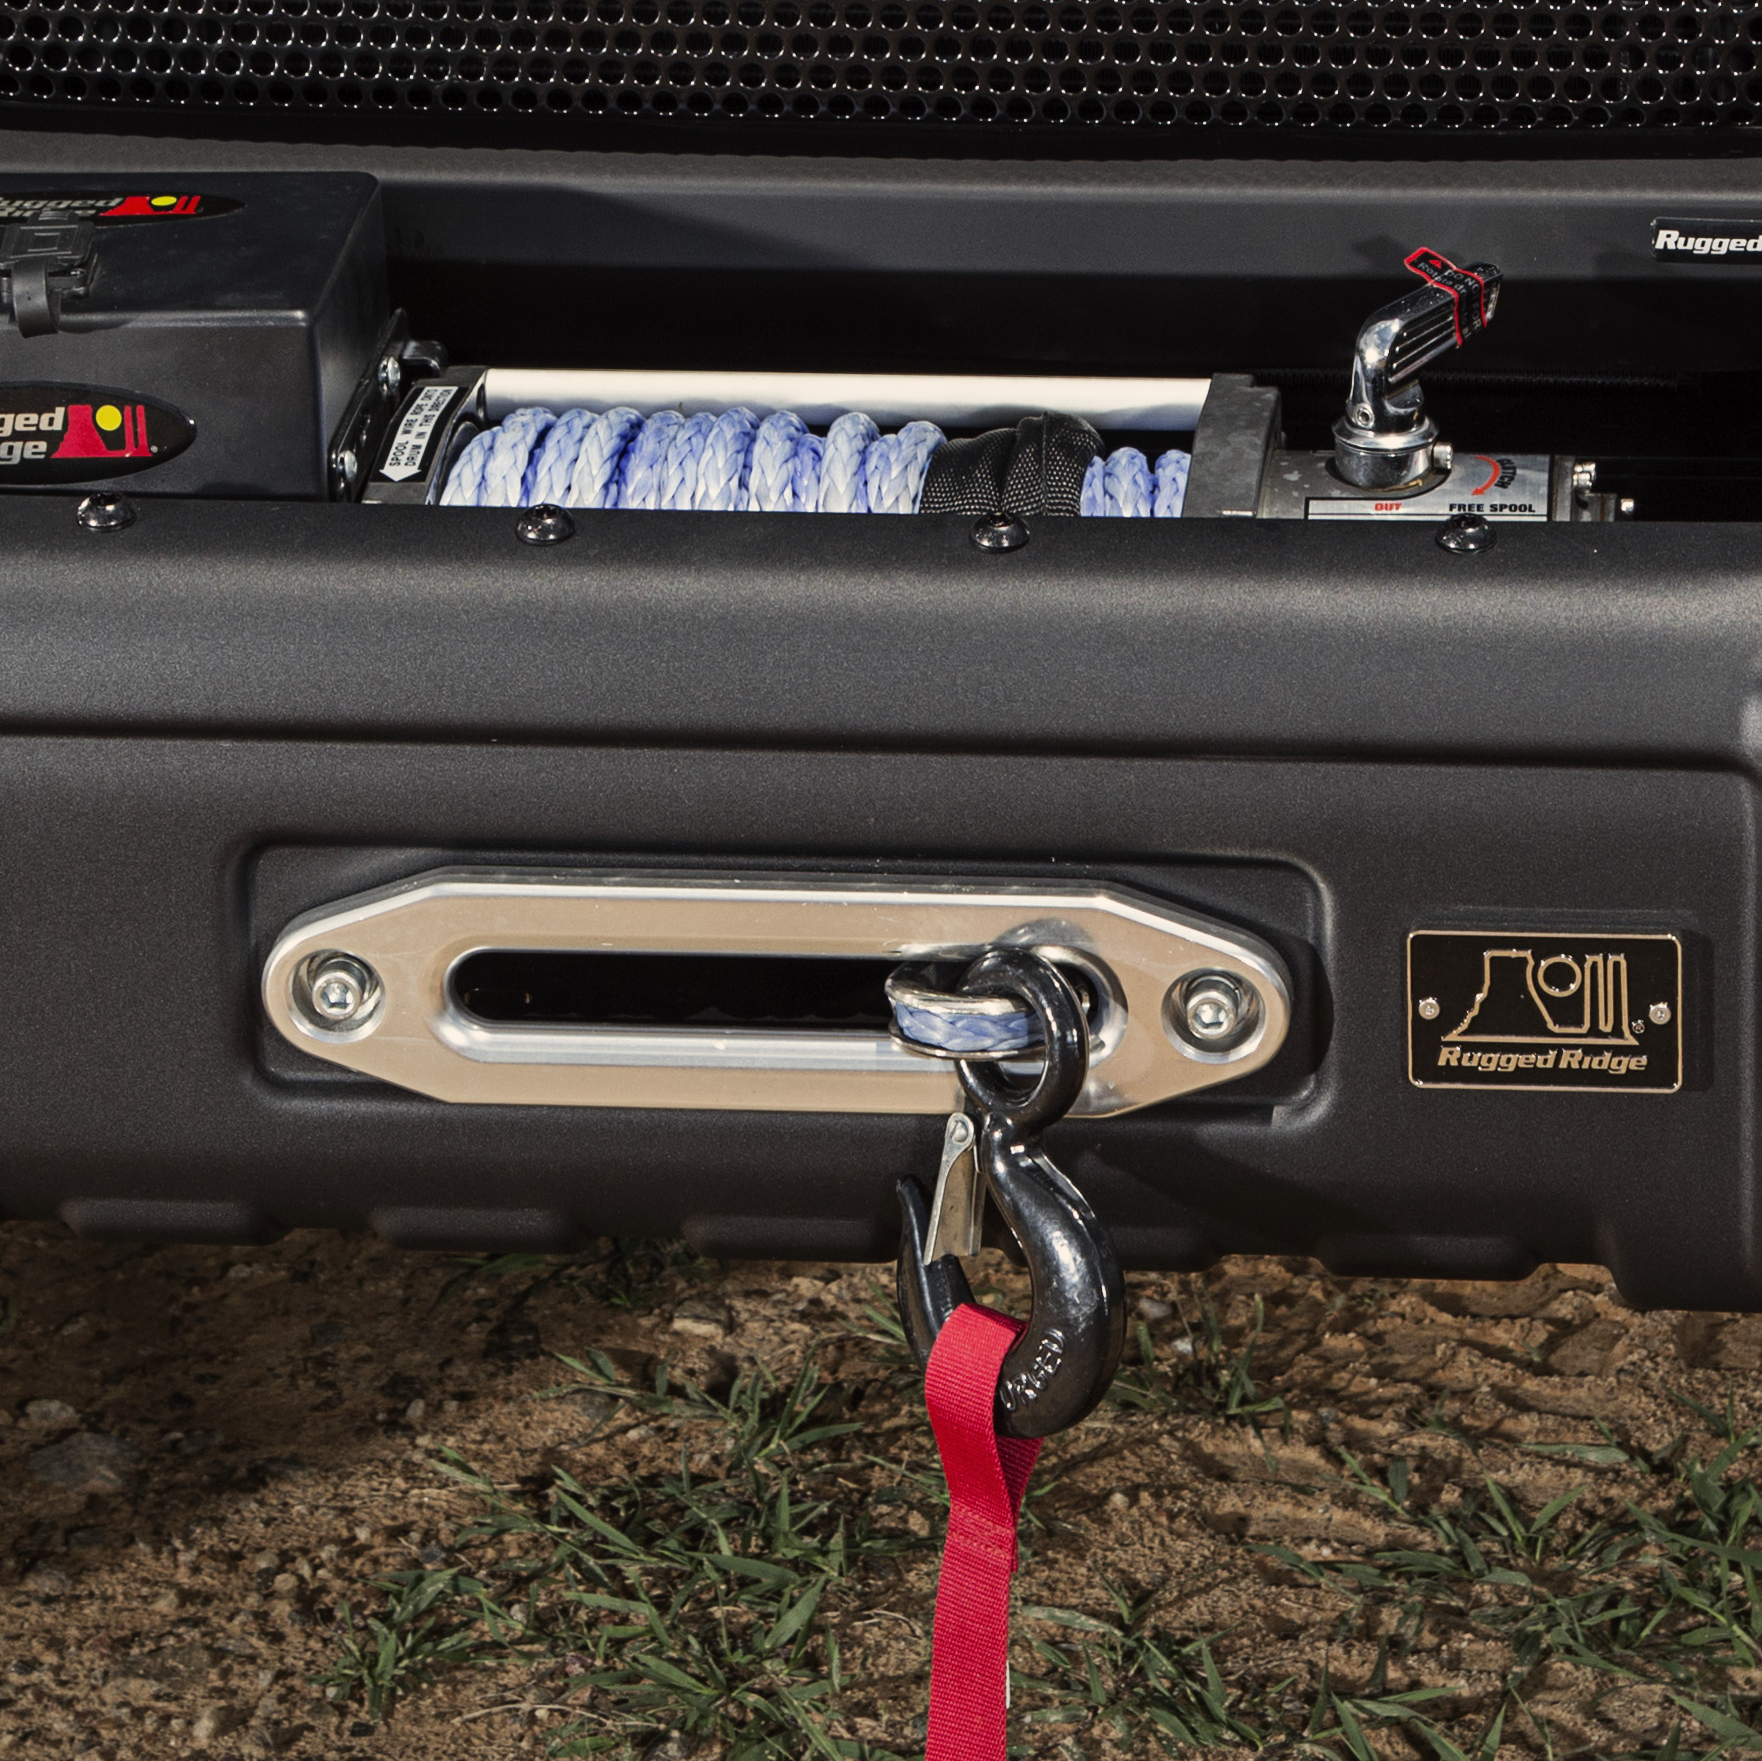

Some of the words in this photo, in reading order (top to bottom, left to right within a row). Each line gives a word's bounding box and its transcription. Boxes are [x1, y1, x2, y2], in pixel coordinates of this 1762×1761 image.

[389, 441, 409, 467] SPOOL
[401, 418, 418, 435] WIRE
[404, 444, 422, 467] DRUM
[419, 414, 436, 427] THIS
[1494, 457, 1517, 489] CLUTCH
[1449, 503, 1484, 513] FREE
[1489, 503, 1536, 513] SPOOL
[1437, 1044, 1558, 1072] Rugged
[1559, 1047, 1648, 1075] Ridge
